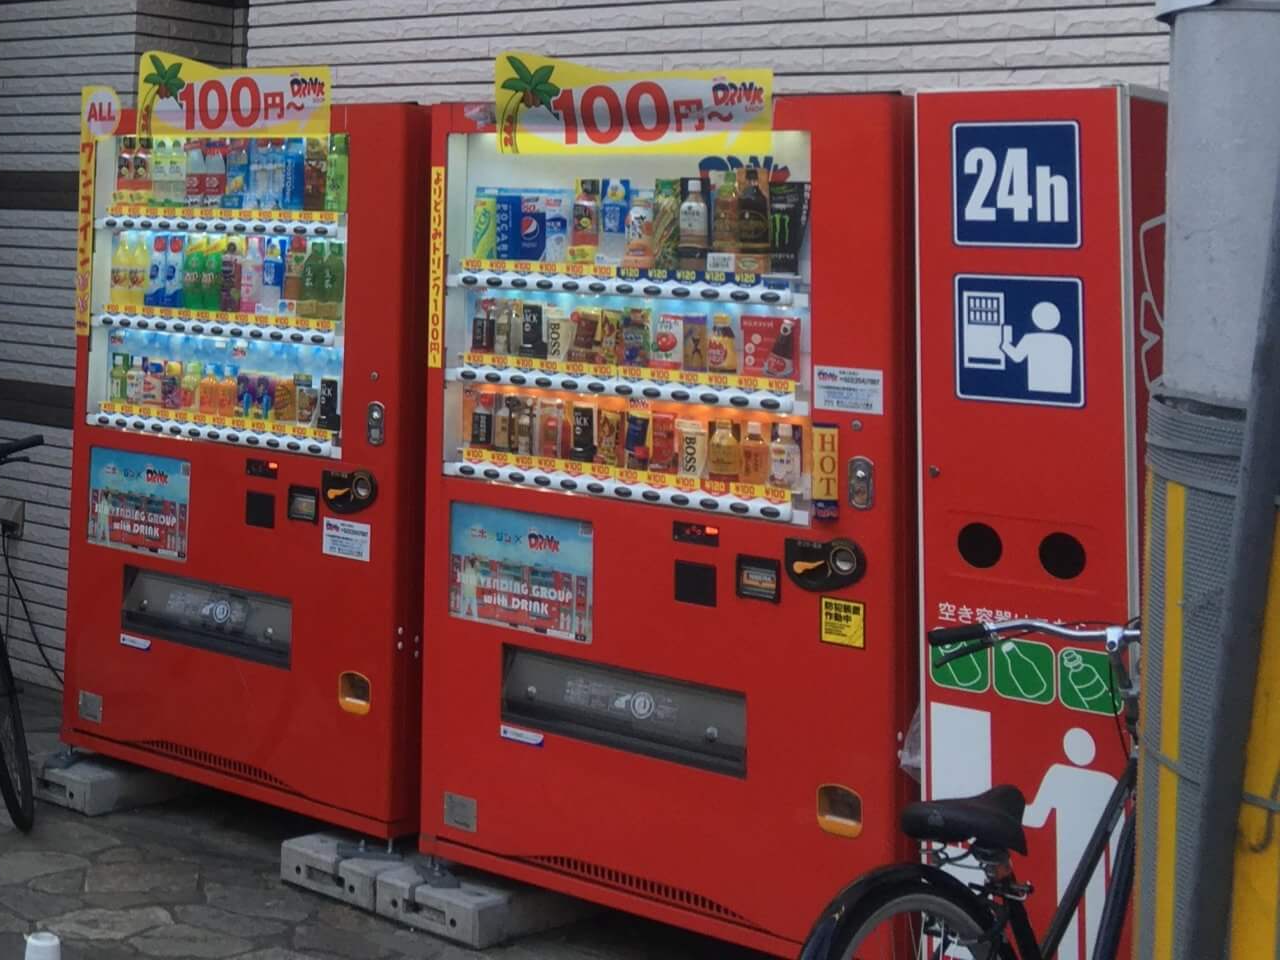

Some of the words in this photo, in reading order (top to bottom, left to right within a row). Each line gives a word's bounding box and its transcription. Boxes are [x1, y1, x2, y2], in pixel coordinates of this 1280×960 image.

[87, 102, 116, 122] ALL
[963, 147, 1070, 224] 24h
[550, 322, 560, 357] BOSS
[685, 435, 697, 473] BOSS
[819, 432, 837, 496] HOT
[483, 593, 508, 608] with
[511, 597, 549, 616] DRINK
[531, 584, 574, 604] GROUP
